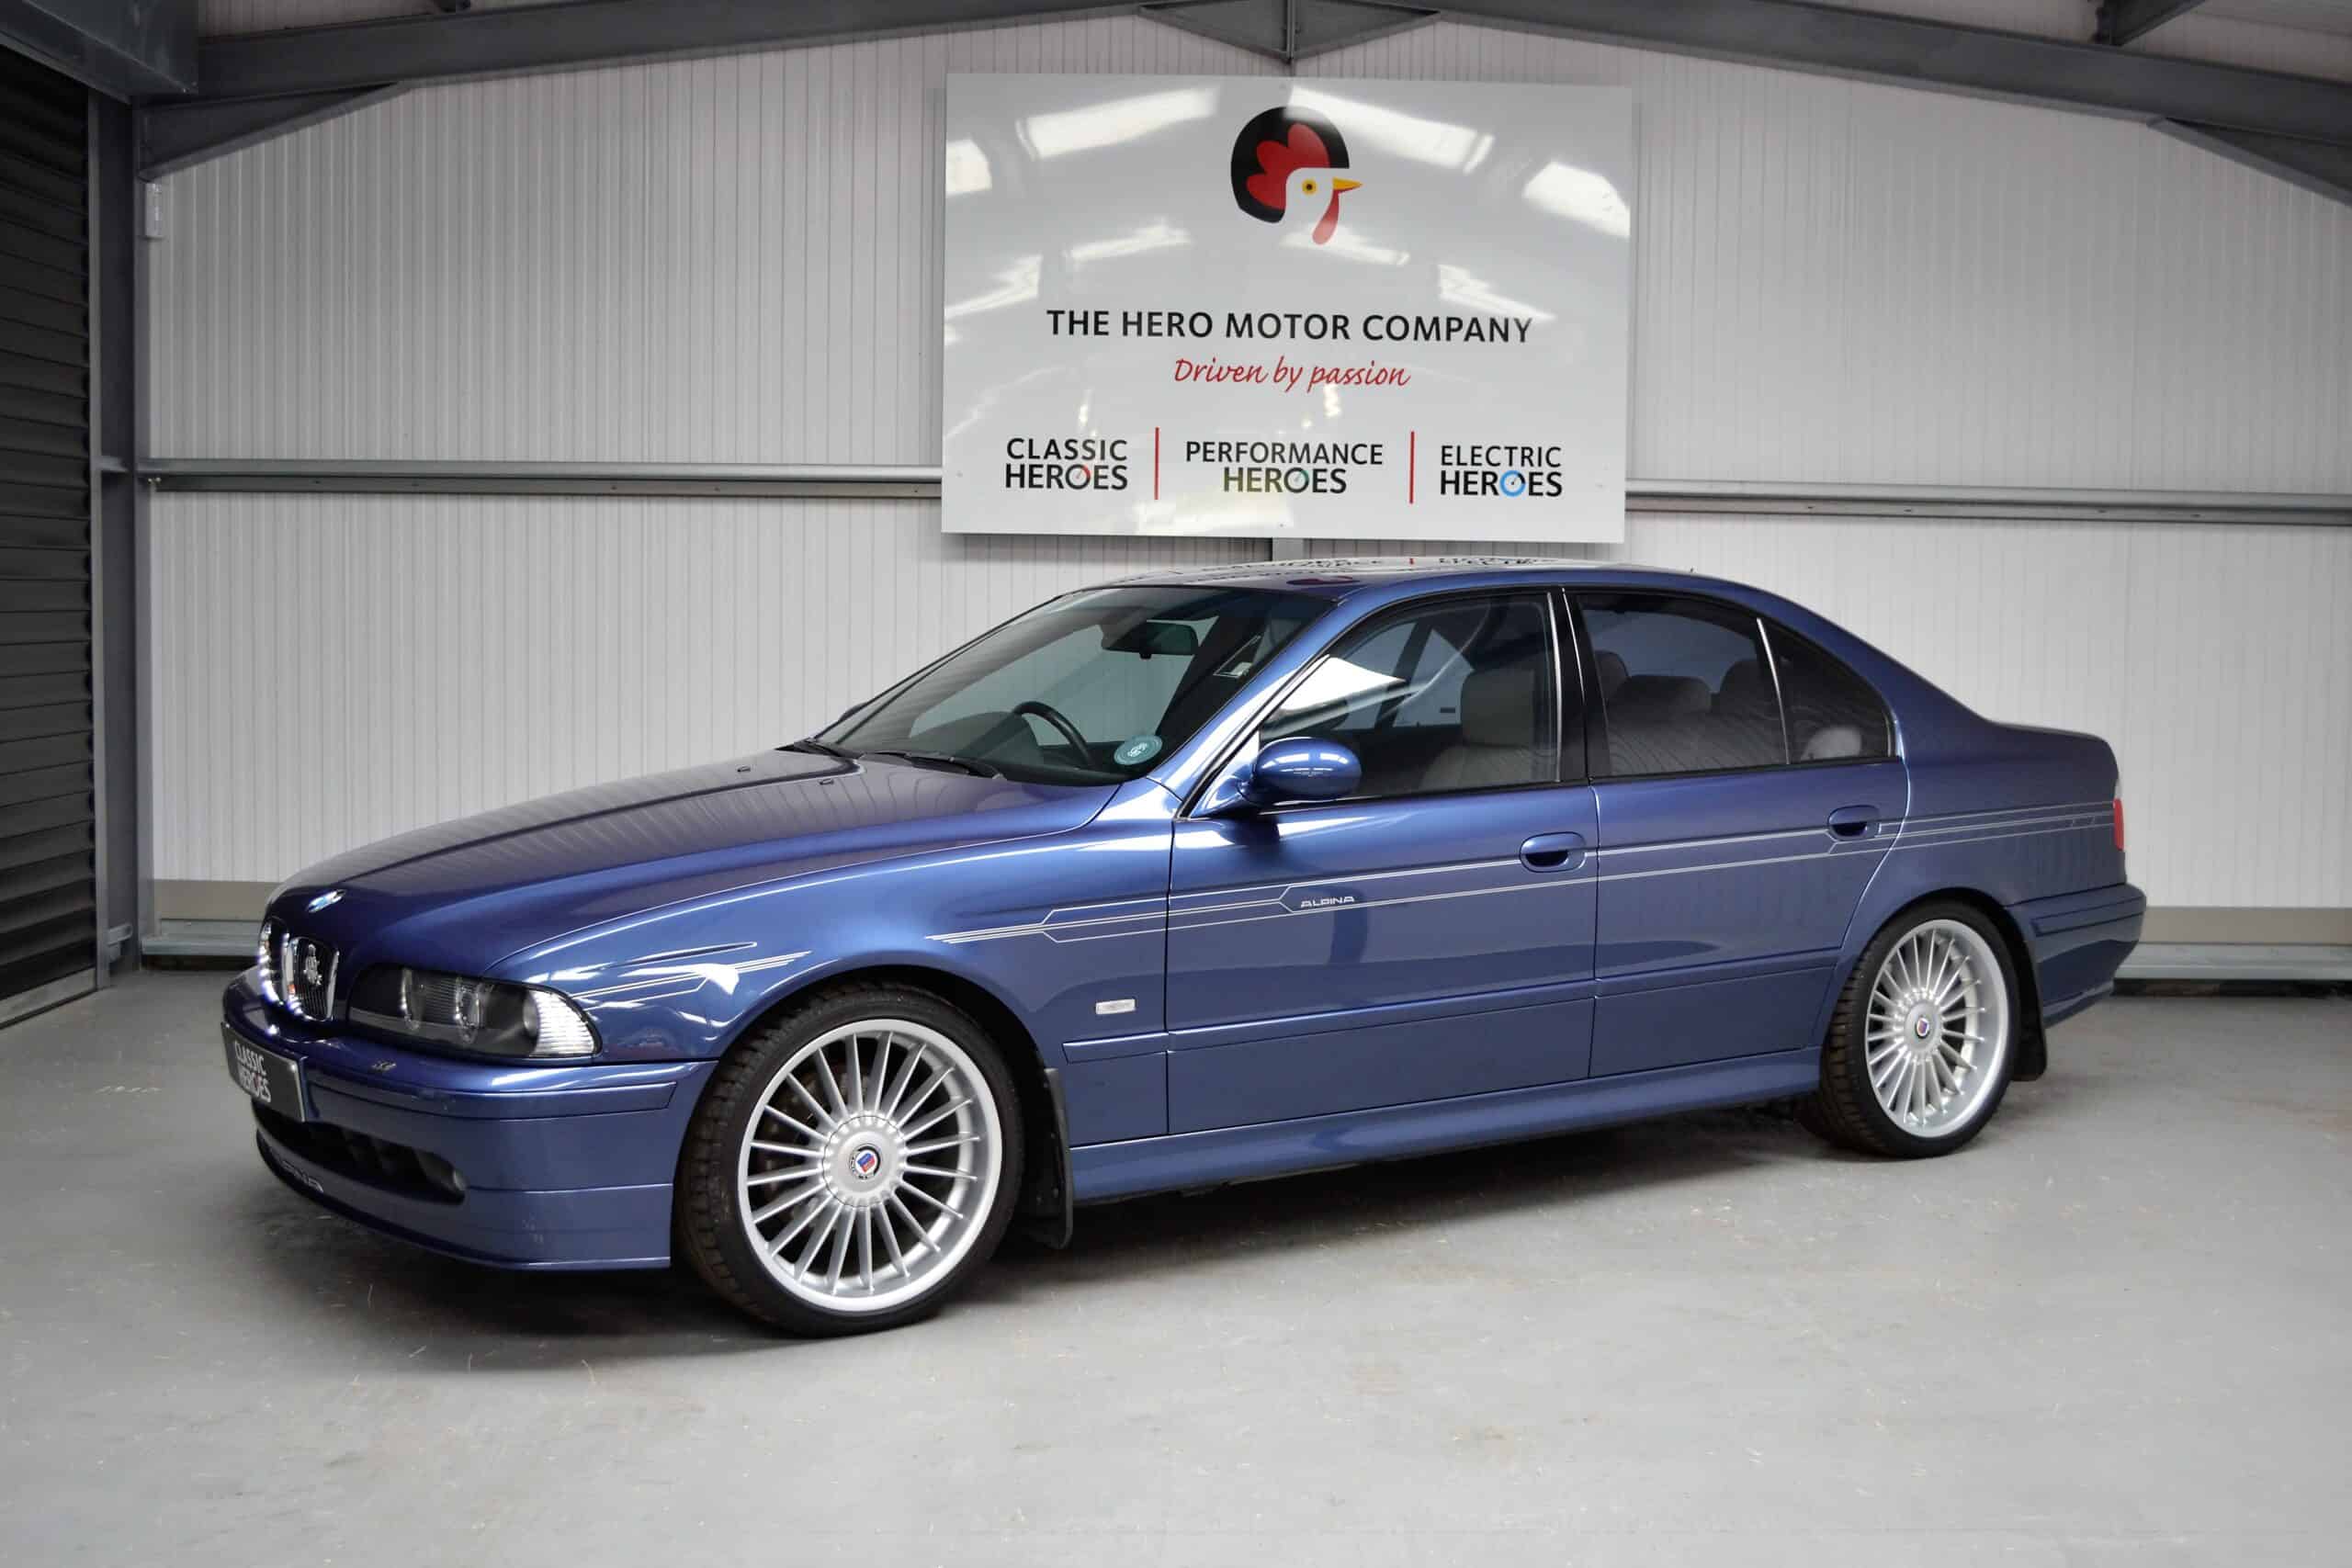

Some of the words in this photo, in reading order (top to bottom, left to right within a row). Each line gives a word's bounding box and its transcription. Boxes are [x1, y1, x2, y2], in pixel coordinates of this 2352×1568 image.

[1046, 310, 1109, 335] THE
[1123, 311, 1213, 338] HERO
[1226, 313, 1351, 340] MOTOR
[1363, 315, 1532, 343] COMPANY
[1175, 357, 1269, 383] Driven
[1273, 355, 1303, 392] by
[1306, 359, 1411, 393] passion
[1006, 438, 1127, 461] CLASSIC
[1186, 441, 1383, 465] PERFORMANCE
[1441, 445, 1562, 468] ELECTRIC
[1005, 463, 1128, 491] HEROES
[1223, 466, 1347, 494] HEROES
[1440, 469, 1563, 498] HEROES
[1300, 896, 1354, 908] ALPINA
[234, 1040, 266, 1076] CLASSIC
